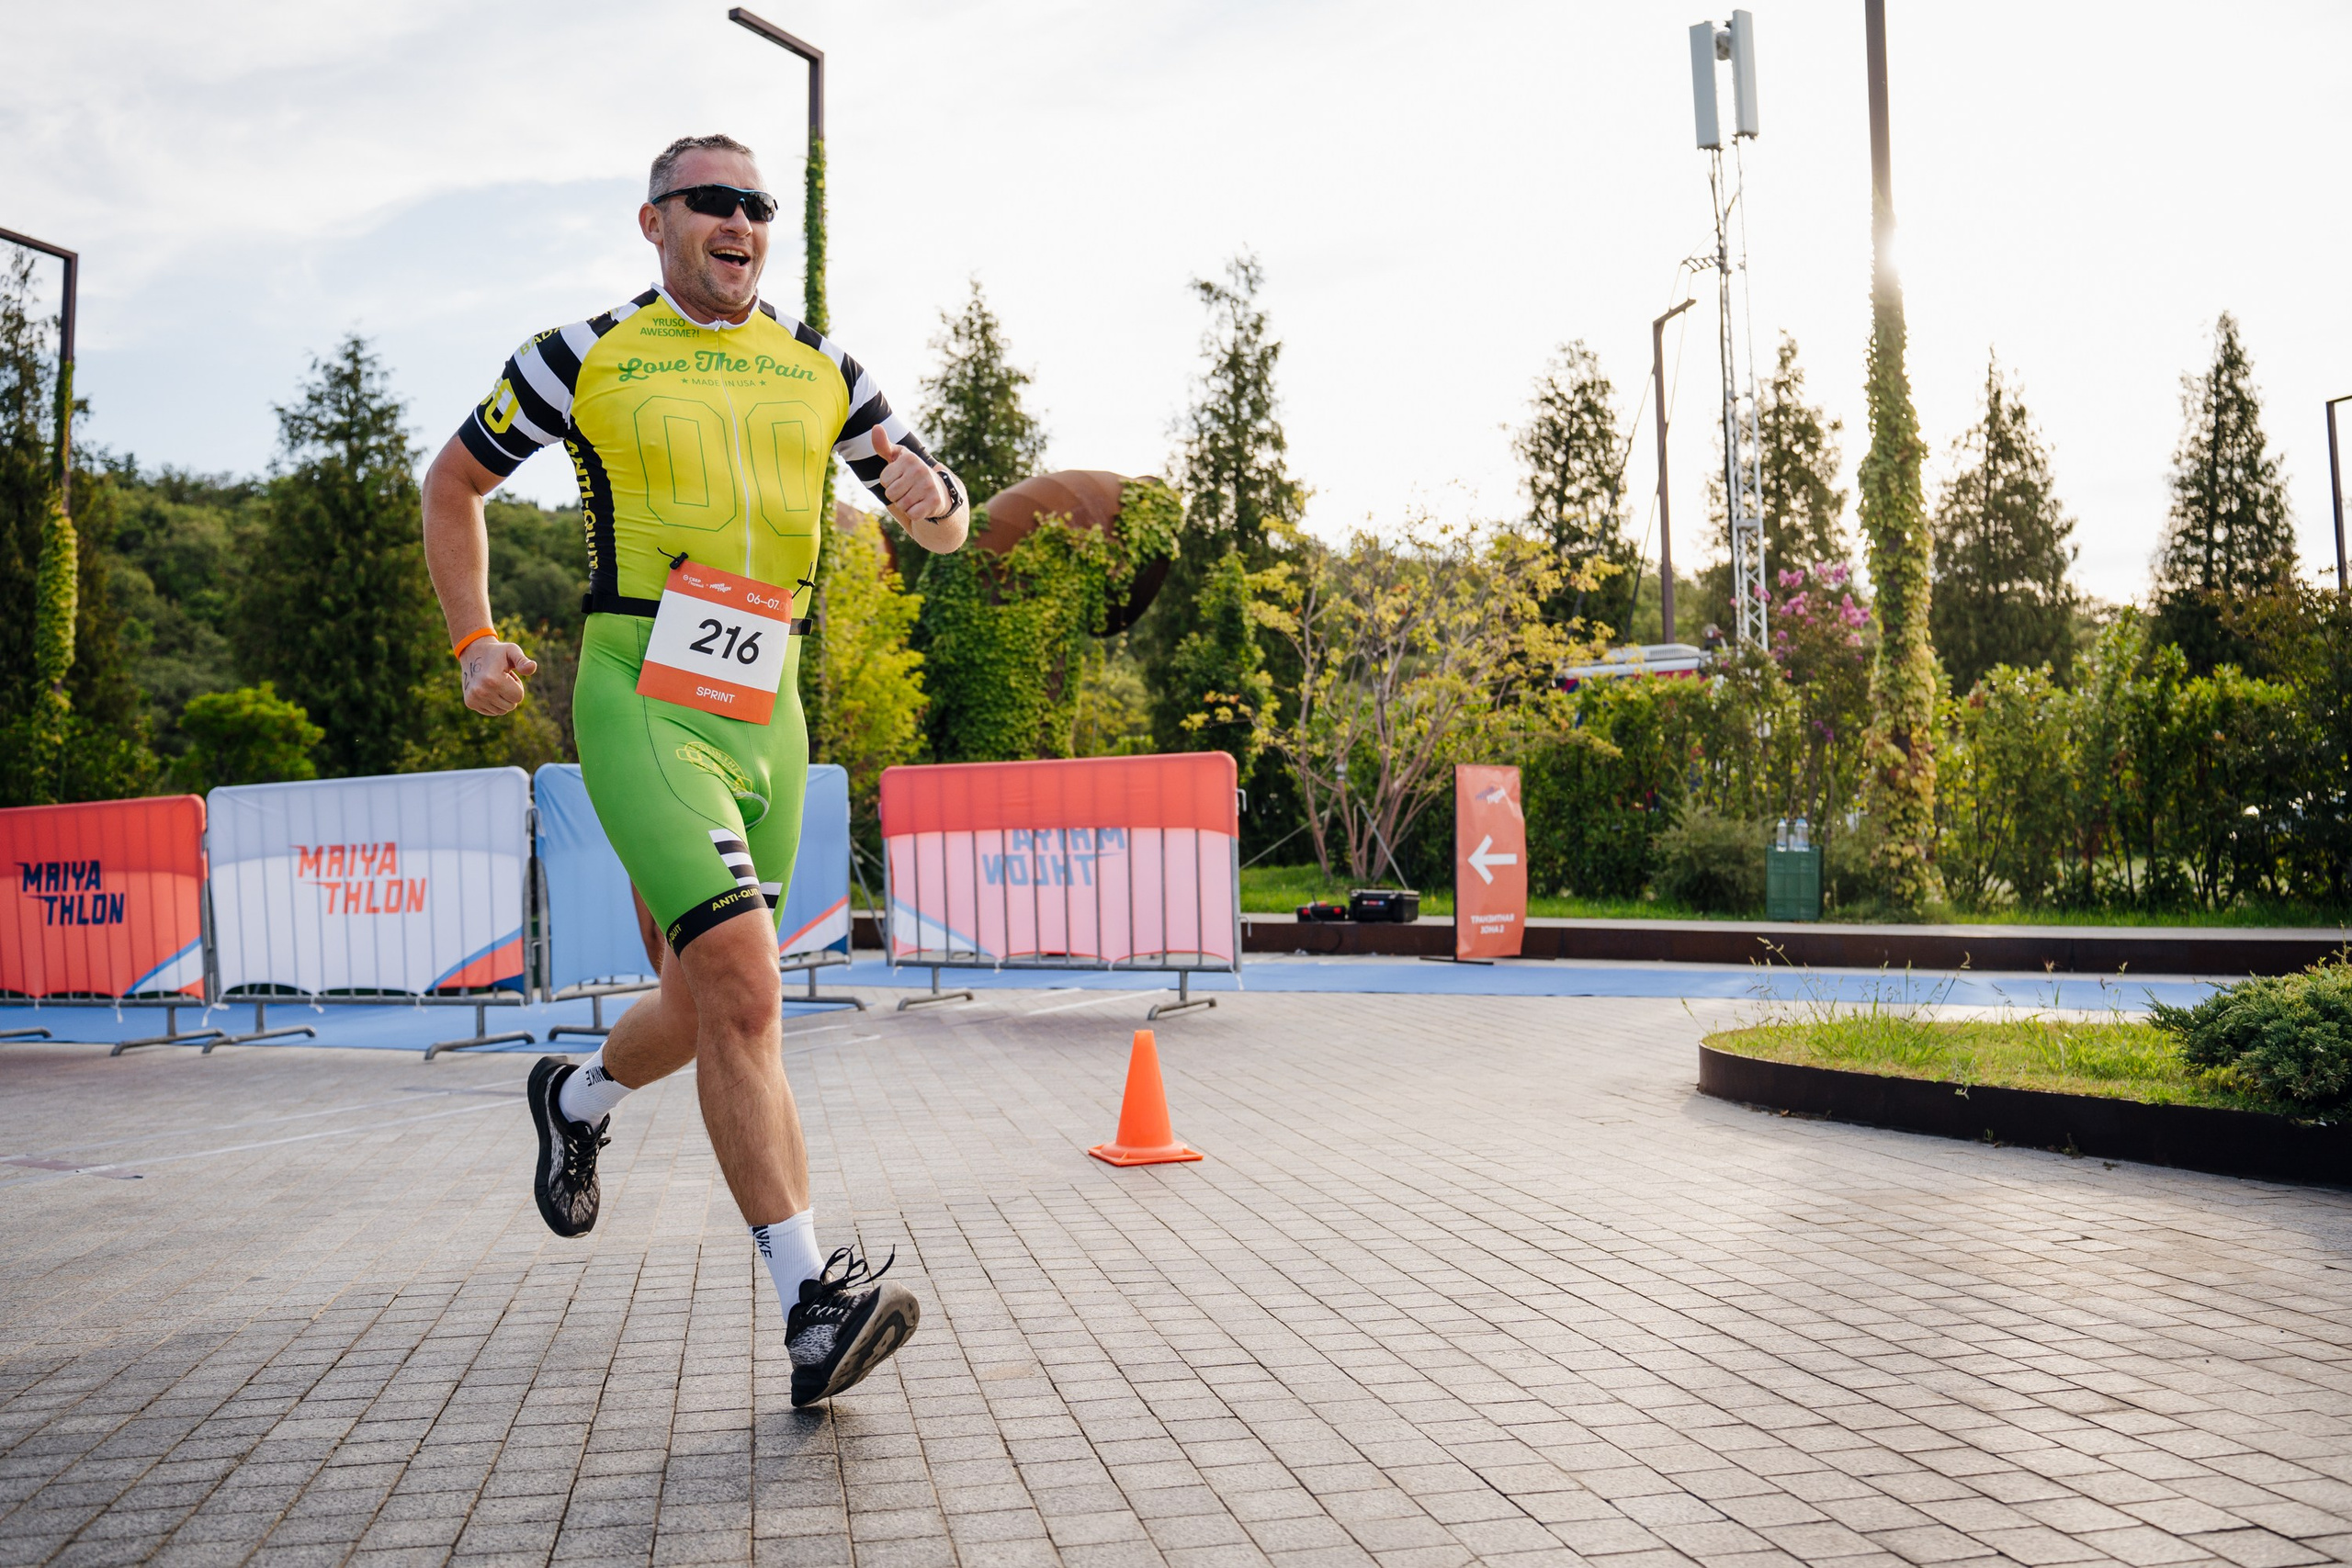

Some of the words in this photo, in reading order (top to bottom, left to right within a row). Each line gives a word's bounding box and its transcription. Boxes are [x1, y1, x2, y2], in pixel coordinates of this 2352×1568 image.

[639, 327, 700, 338] AWESOME?!
[652, 318, 685, 327] YRUSO
[617, 357, 690, 382] Love
[694, 350, 751, 373] The
[754, 355, 818, 382] Pain
[692, 378, 719, 387] MADE
[725, 379, 736, 388] IN
[689, 618, 763, 665] 216
[463, 656, 483, 691] 216
[695, 686, 736, 704] SPRINT
[290, 841, 398, 878] MAIYA
[17, 860, 101, 892] MAIYA
[35, 893, 125, 926] THLON
[308, 878, 427, 915] THLON
[712, 887, 760, 911] ANTI-QUIT
[585, 1066, 605, 1087] NIKE
